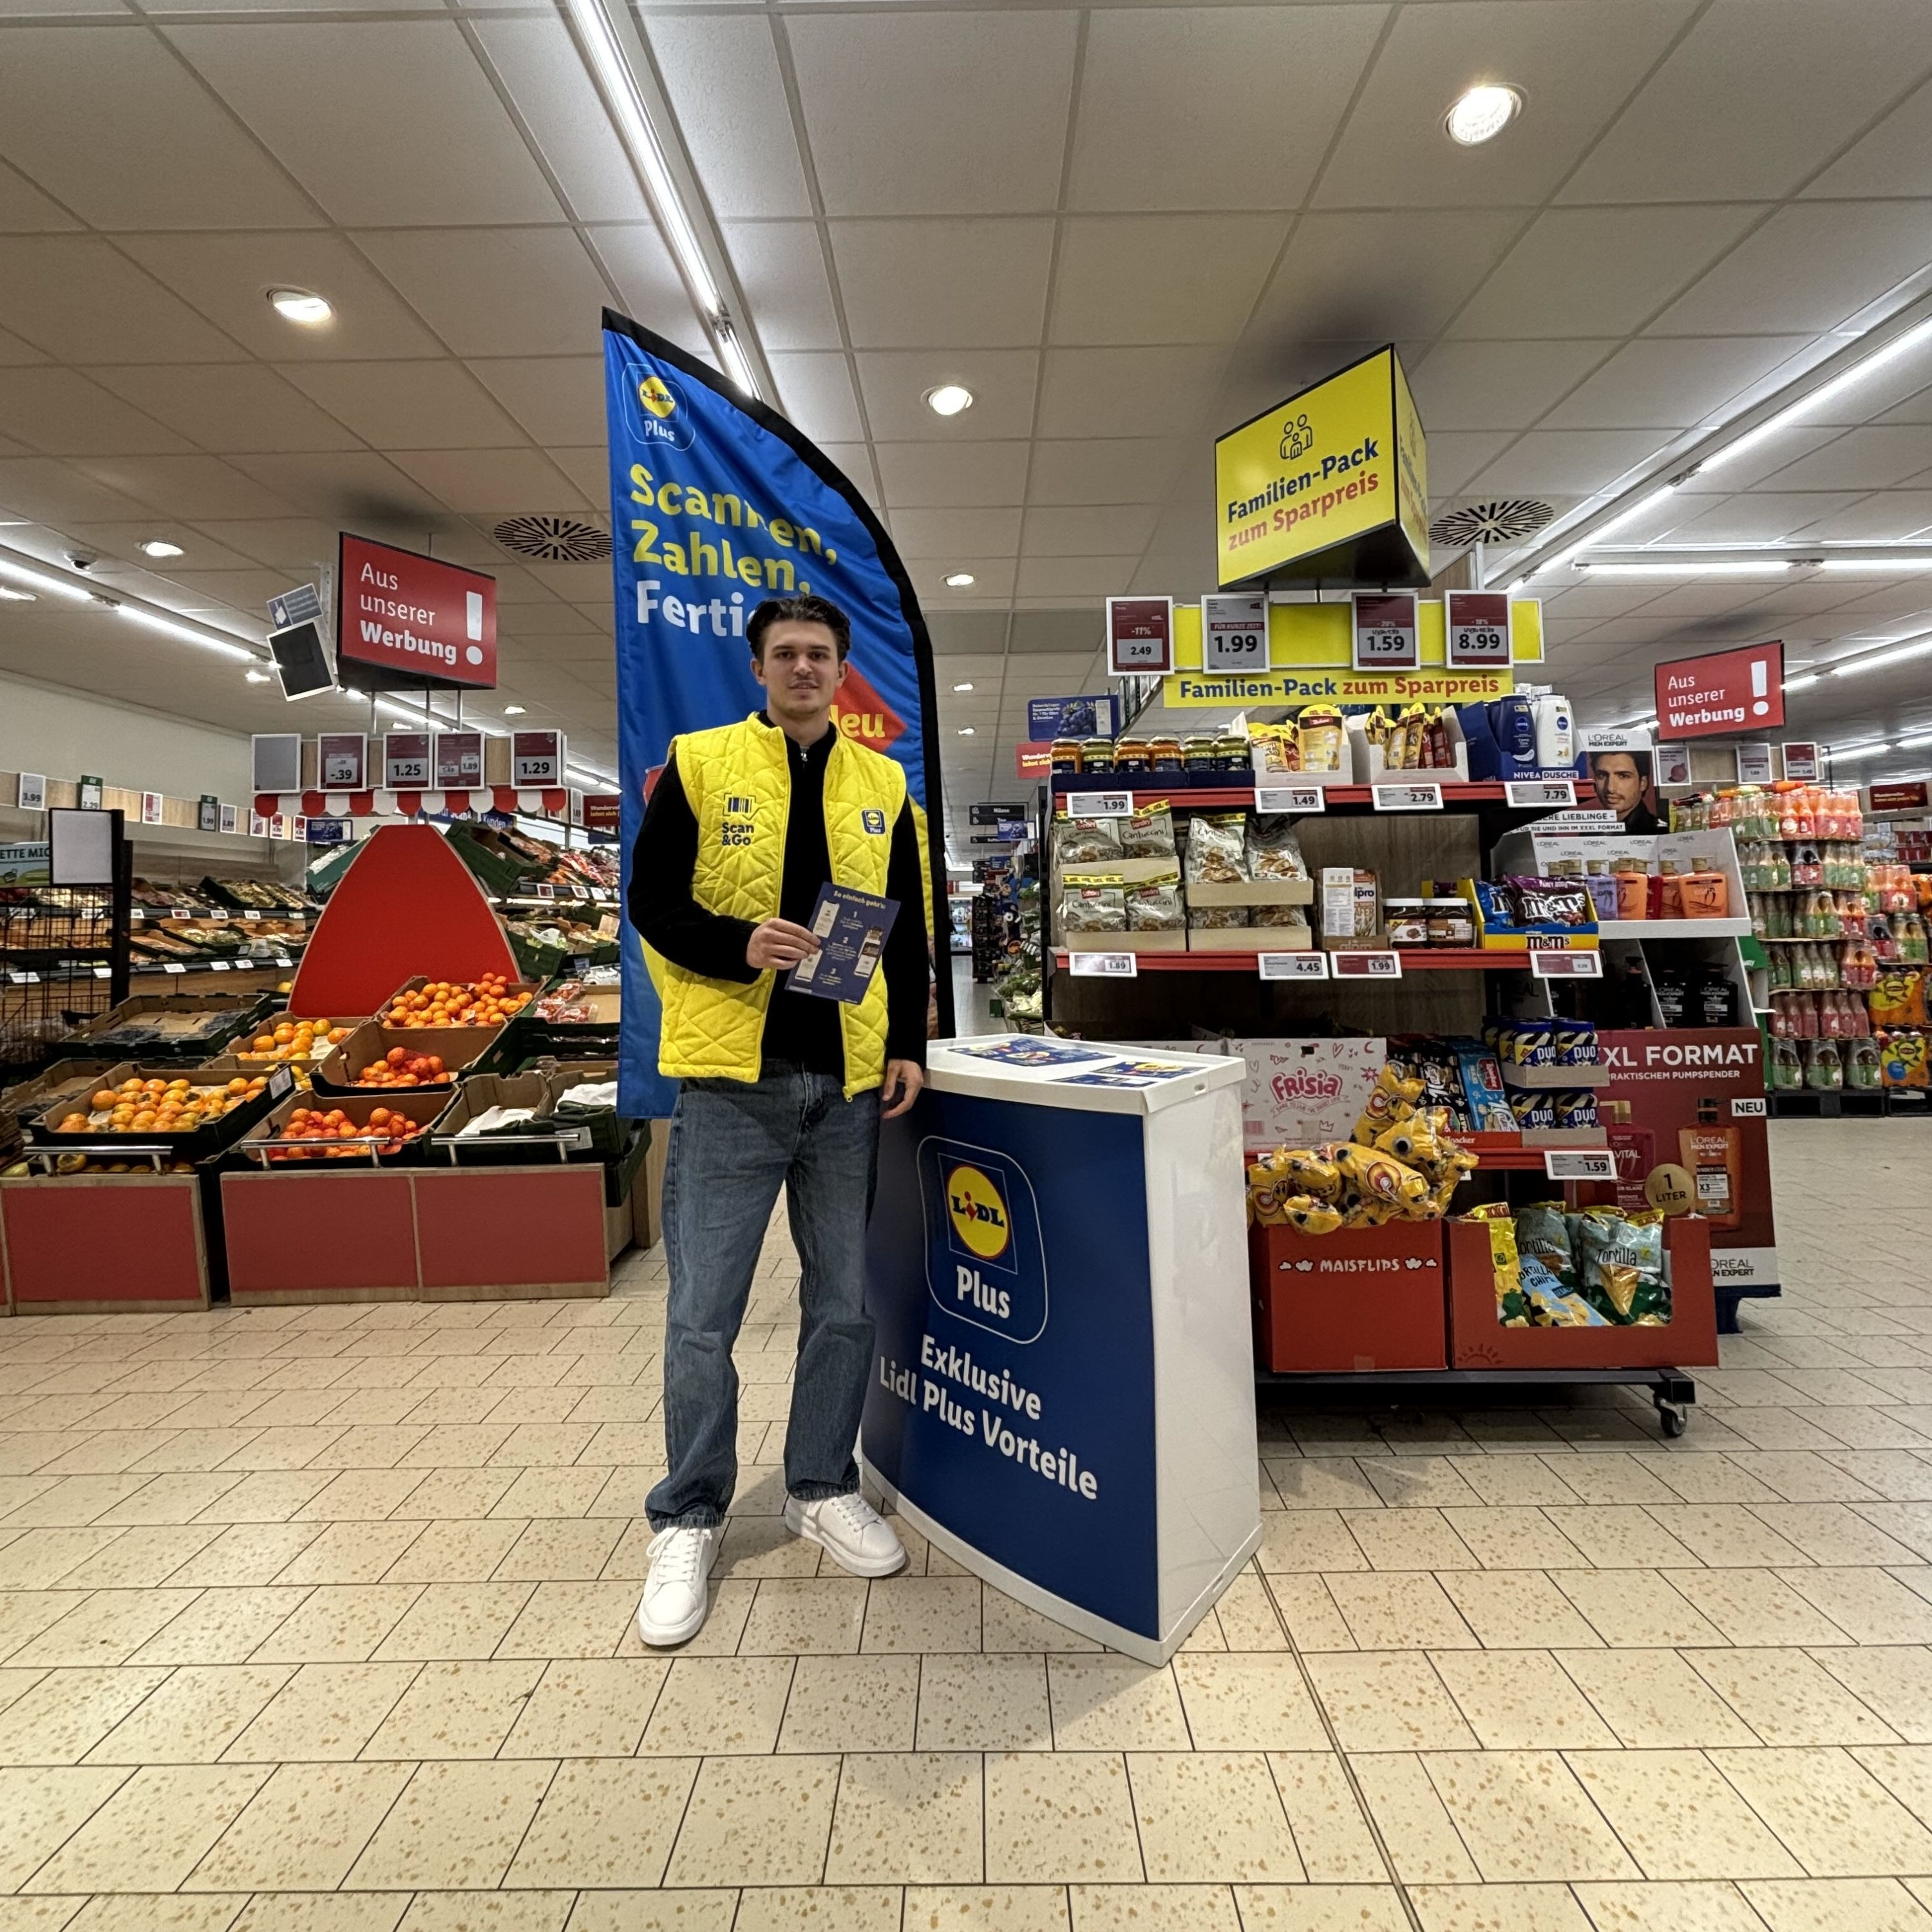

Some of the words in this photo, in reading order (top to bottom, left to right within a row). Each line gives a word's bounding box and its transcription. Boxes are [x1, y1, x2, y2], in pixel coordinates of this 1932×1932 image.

[644, 420, 675, 442] Plus
[1227, 437, 1379, 524] Familien-Pack
[1228, 520, 1267, 551] zum
[1273, 470, 1379, 532] Sparpreis
[631, 520, 810, 594] Zahlen,
[361, 562, 399, 591] Aus
[360, 594, 436, 626] unserer
[636, 580, 752, 637] Ferti
[360, 620, 457, 665] Werbung
[1214, 635, 1257, 653] 1.99
[1367, 636, 1405, 651] 1.59
[1459, 634, 1501, 650] 8.99
[1130, 647, 1151, 656] 2.49
[1180, 678, 1338, 699] Familien-Pack
[1343, 681, 1388, 696] zum
[1394, 674, 1499, 699] Sparpreis
[1668, 675, 1696, 691] Aus
[1668, 688, 1725, 708] unserer
[1669, 706, 1745, 728] Werbung
[330, 770, 352, 780] -.39
[393, 764, 421, 777] 1.25
[521, 762, 550, 774] 1.29
[23, 792, 41, 802] 3.99
[1293, 796, 1315, 806] 1.49
[1411, 793, 1434, 802] 2.79
[1544, 790, 1567, 799] 7.79
[1103, 800, 1125, 810] 1.99
[721, 822, 754, 835] Scan
[721, 834, 752, 846] &Go
[0, 848, 25, 860] ETTE
[1354, 887, 1374, 899] lpro
[1296, 961, 1320, 972] 4.45
[1372, 962, 1390, 971] 1.99
[1537, 1046, 1556, 1060] DUO
[1573, 1045, 1596, 1059] DUO
[1598, 1045, 1638, 1066] XL
[1645, 1044, 1758, 1066] FORMAT
[1609, 1071, 1670, 1080] RAKTISCHEM
[1672, 1070, 1740, 1079] PUMPSPENDER
[1735, 1102, 1763, 1113] NEU
[1531, 1109, 1553, 1123] DUO
[1573, 1108, 1596, 1122] DUO
[1584, 1162, 1607, 1171] 1.59
[1663, 1173, 1673, 1189] 1
[1656, 1191, 1687, 1202] LITER
[1320, 1258, 1399, 1273] MAISFLIPS
[956, 1264, 1010, 1320] Plus
[921, 1334, 1041, 1420] Exklusive
[880, 1356, 918, 1406] Lidl
[923, 1379, 975, 1437] Plus
[983, 1409, 1098, 1501] Vorteile
